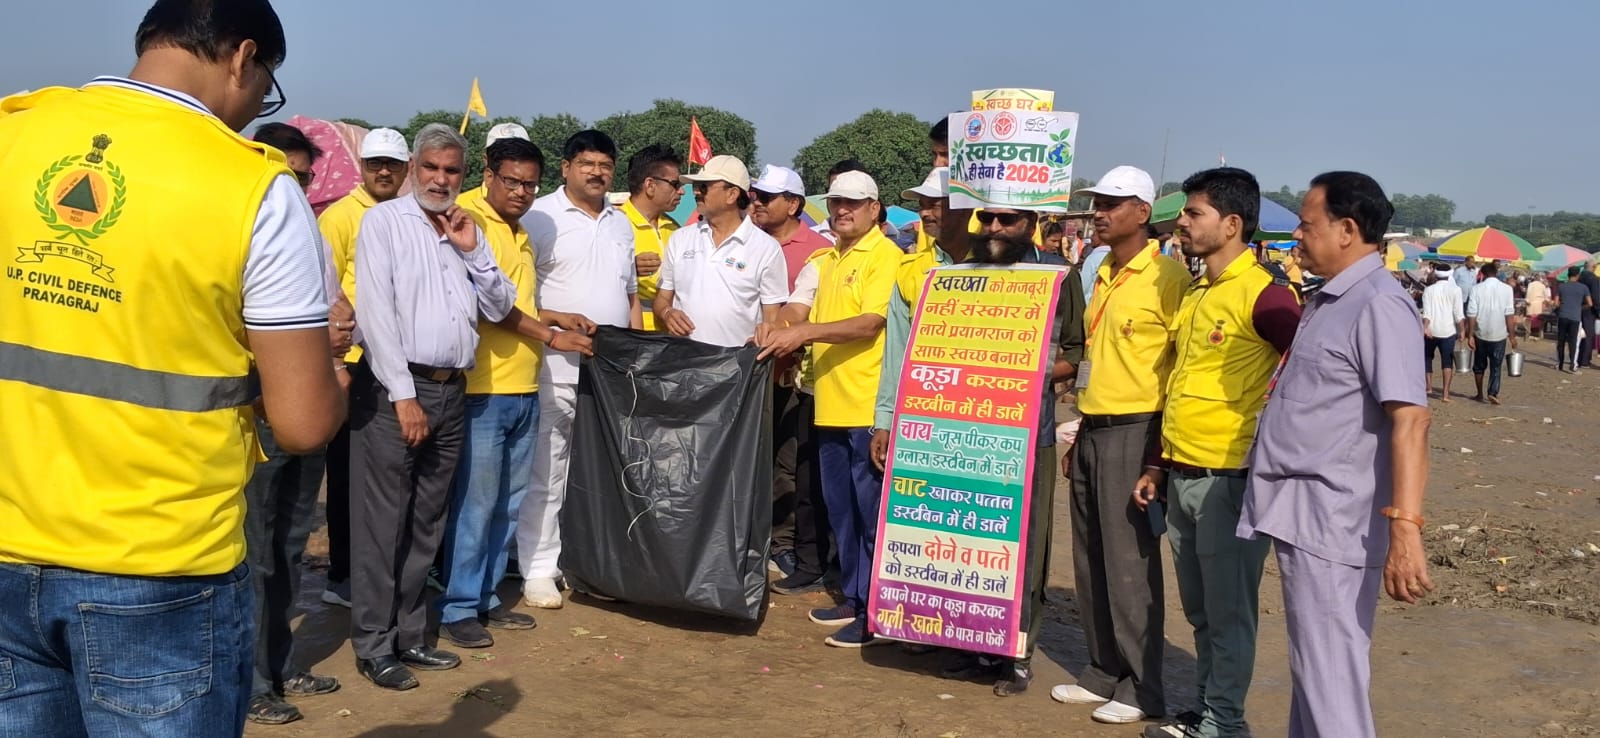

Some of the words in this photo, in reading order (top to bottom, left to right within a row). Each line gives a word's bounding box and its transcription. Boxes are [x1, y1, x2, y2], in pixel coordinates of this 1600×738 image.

[986, 98, 1012, 110] स्वच्छ
[1016, 98, 1034, 110] घर
[965, 142, 1048, 163] स्वच्छता
[968, 163, 977, 180] ही
[978, 163, 996, 179] सेवा
[997, 162, 1006, 180] है
[1006, 164, 1050, 184] 2026
[7, 266, 24, 281] U.P.
[28, 271, 64, 289] CIVIL
[67, 279, 123, 303] DEFENCE
[933, 275, 989, 293] स्वच्छता
[989, 277, 1004, 294] को
[1006, 277, 1048, 300] मजबूरी
[23, 287, 100, 313] PRAYAGRAJ
[925, 298, 960, 316] नहीं
[960, 300, 1021, 319] संस्कार
[1024, 302, 1045, 321] में
[919, 320, 948, 337] लाये
[949, 325, 1016, 342] प्रयागराज
[1017, 326, 1038, 343] को
[914, 345, 947, 359] साफ
[949, 347, 988, 362] स्वच्छ
[989, 348, 1035, 367] बनायें
[910, 364, 962, 392] कूड़ा
[966, 373, 1030, 393] करकट
[959, 396, 977, 416] में
[976, 399, 993, 418] ही
[995, 403, 1027, 422] डालें
[965, 428, 998, 450] पीकर
[1000, 438, 1023, 453] कप
[896, 450, 930, 466] ग्लास
[979, 456, 994, 474] में
[994, 459, 1022, 477] डालें
[893, 477, 928, 498] चाट
[928, 486, 973, 505] खाकर
[975, 492, 1014, 510] पत्तल
[946, 508, 962, 527] में
[962, 511, 977, 530] ही
[980, 515, 1010, 534] डालें
[888, 540, 922, 560] कृपया
[924, 535, 958, 563] दोने
[961, 546, 974, 566] व
[977, 545, 1012, 571] पत्ते
[885, 558, 901, 576] को
[950, 568, 965, 587] में
[965, 571, 979, 590] ही
[983, 575, 1009, 593] डालें
[880, 584, 910, 602] अपने
[910, 591, 927, 605] घर
[928, 594, 943, 609] का
[968, 603, 1006, 620] करकट
[945, 621, 954, 638] के
[956, 627, 974, 643] पास
[975, 631, 984, 645] न
